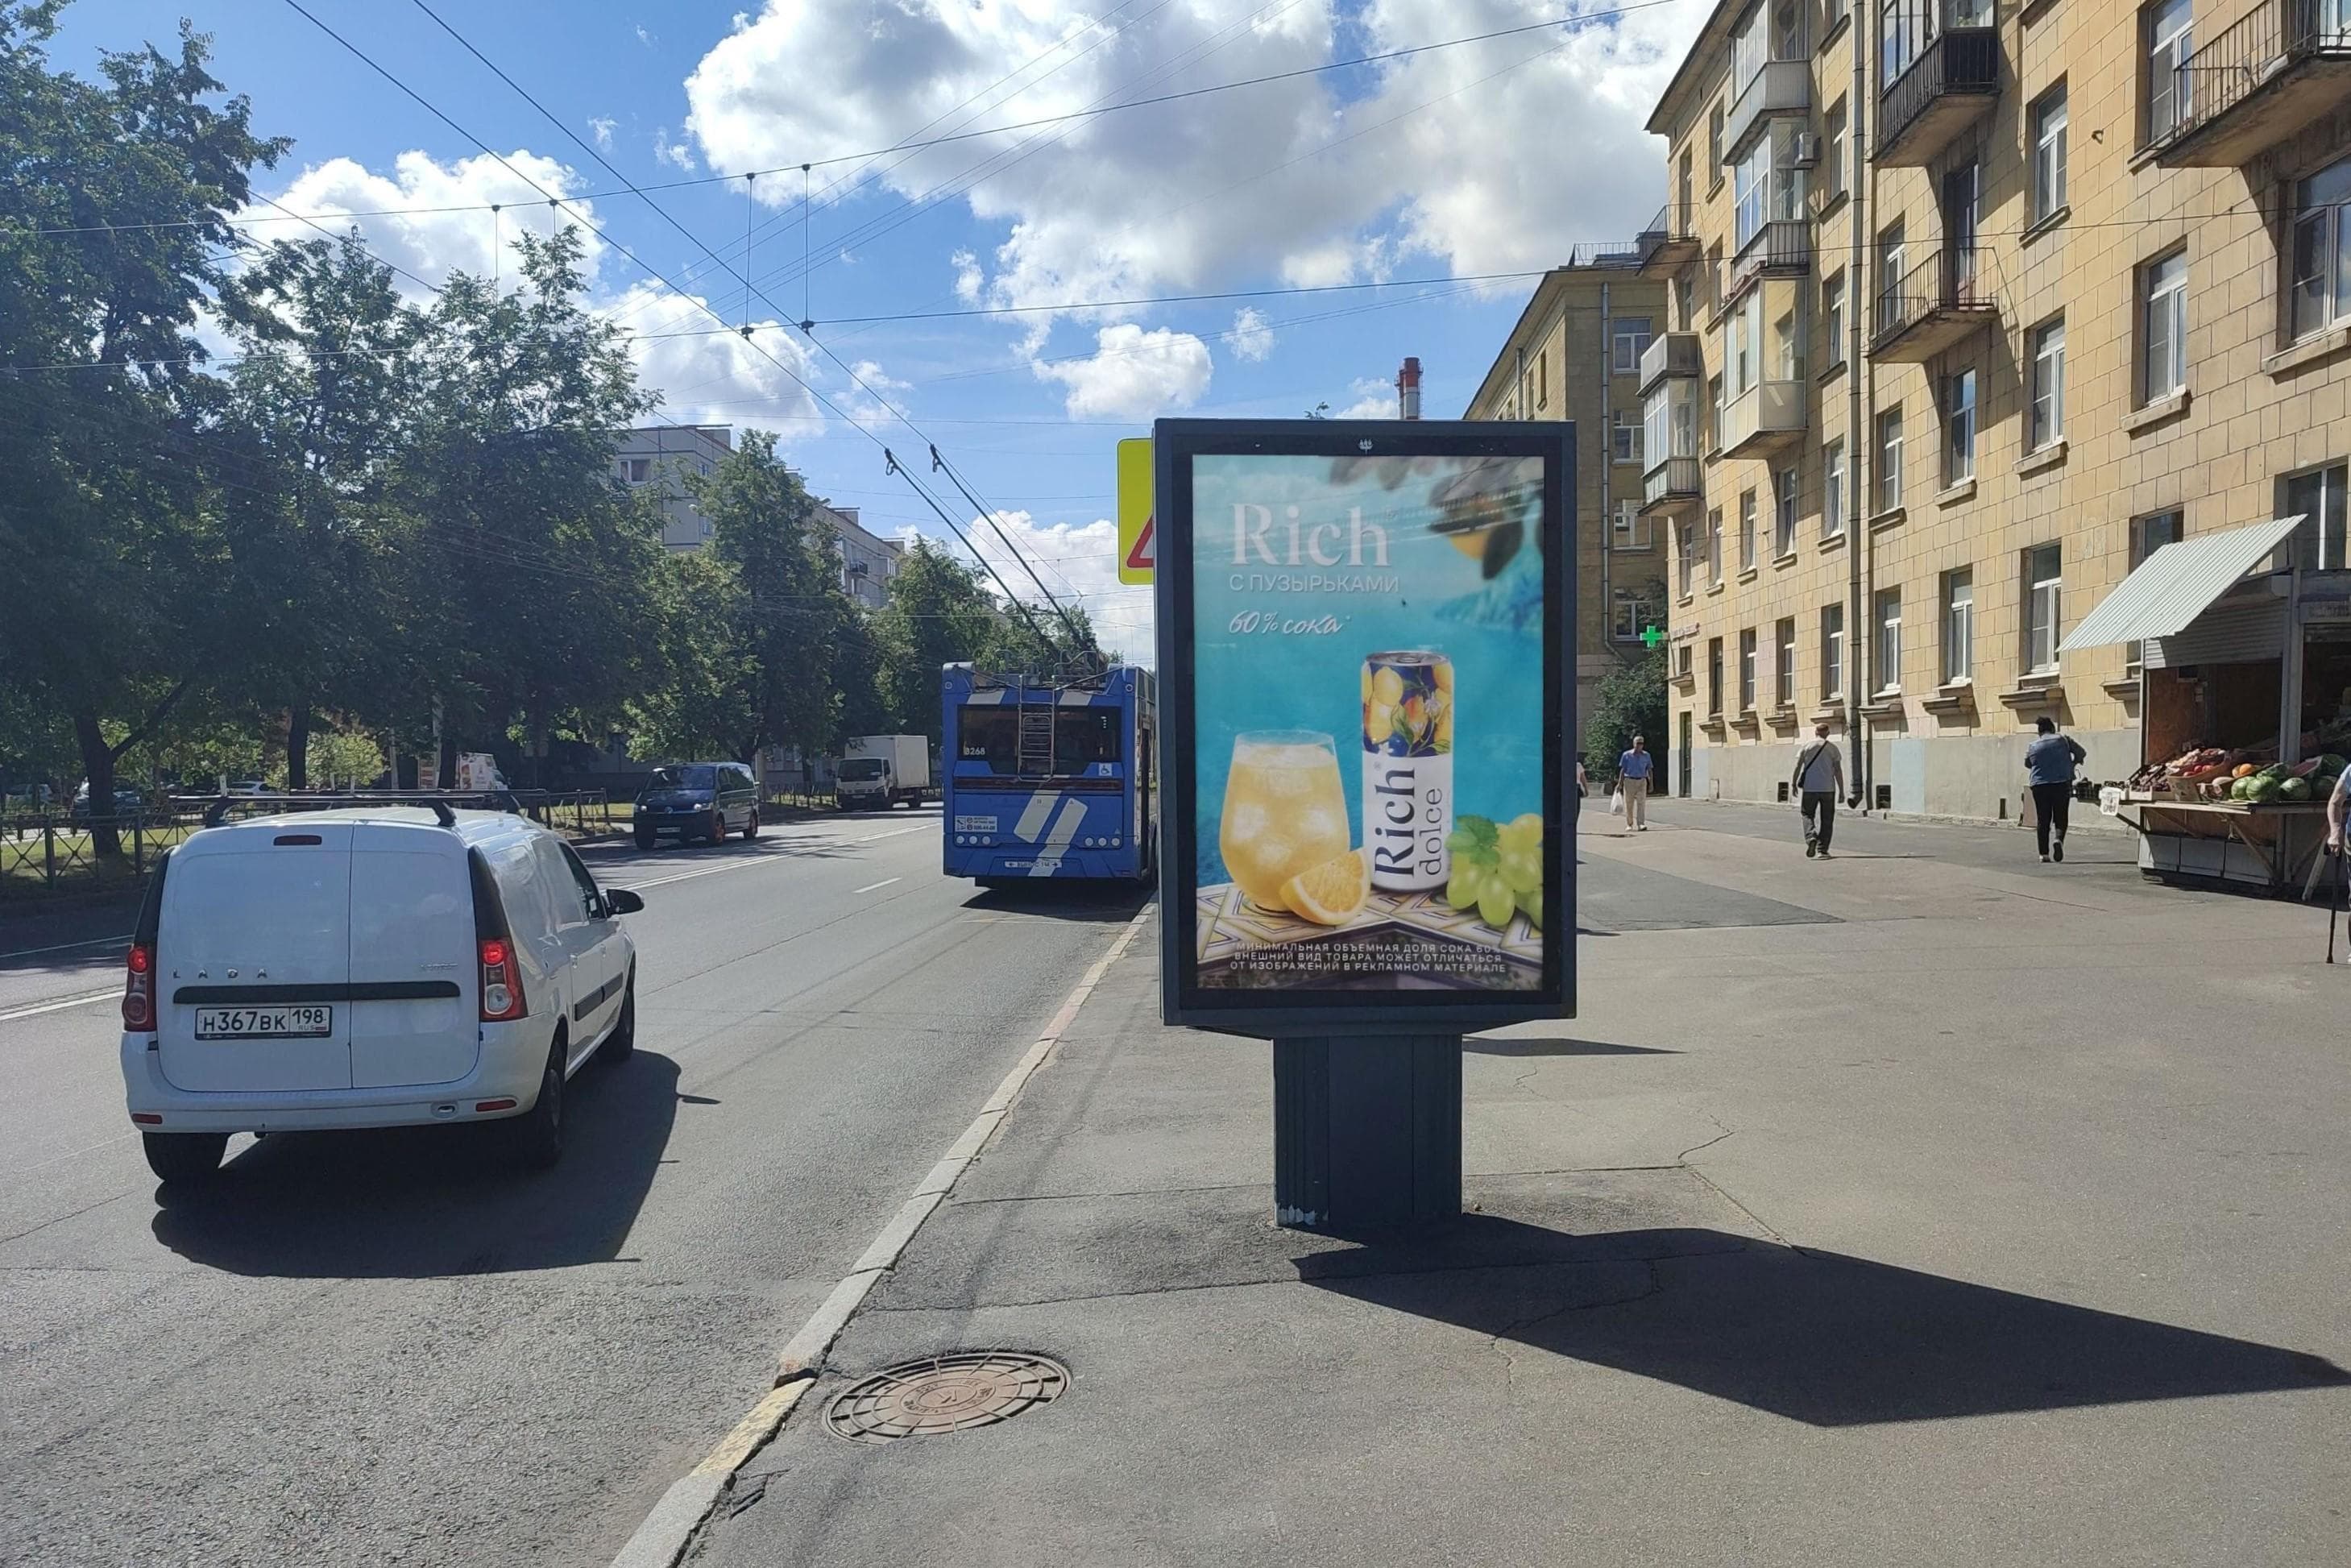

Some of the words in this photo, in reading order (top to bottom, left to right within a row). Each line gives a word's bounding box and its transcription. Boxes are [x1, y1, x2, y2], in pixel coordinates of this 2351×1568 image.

[1230, 503, 1391, 566] Rich
[1229, 575, 1244, 591] С
[1250, 575, 1399, 592] ПУЗЫРЬКАМИ
[1229, 610, 1278, 634] 60%
[1375, 767, 1415, 878] Rich
[1419, 788, 1442, 876] dolce
[1237, 942, 1329, 952] МИНИМАЛЬНАЯ
[1333, 943, 1399, 952] ОБЪЕМНАЯ
[1404, 944, 1436, 952] ДОЛЯ
[1440, 944, 1472, 953] СОКА
[1234, 952, 1293, 960] ВНЕШНИЙ
[1298, 953, 1321, 961] ВИД
[1327, 953, 1371, 961] ТОВАРА
[1376, 953, 1418, 962] МОЖЕТ
[1424, 954, 1502, 962] ОТЛИЧАТЬСЯ
[172, 969, 267, 979] LADA
[1230, 961, 1245, 970] ОТ
[1250, 961, 1340, 971] ИЗОБРАЖЕНИЙ
[1344, 963, 1350, 971] В
[1355, 963, 1429, 972] РЕКЛАМНОМ
[1434, 964, 1506, 973] МАТЕРИАЛЕ
[292, 1009, 323, 1024] 198
